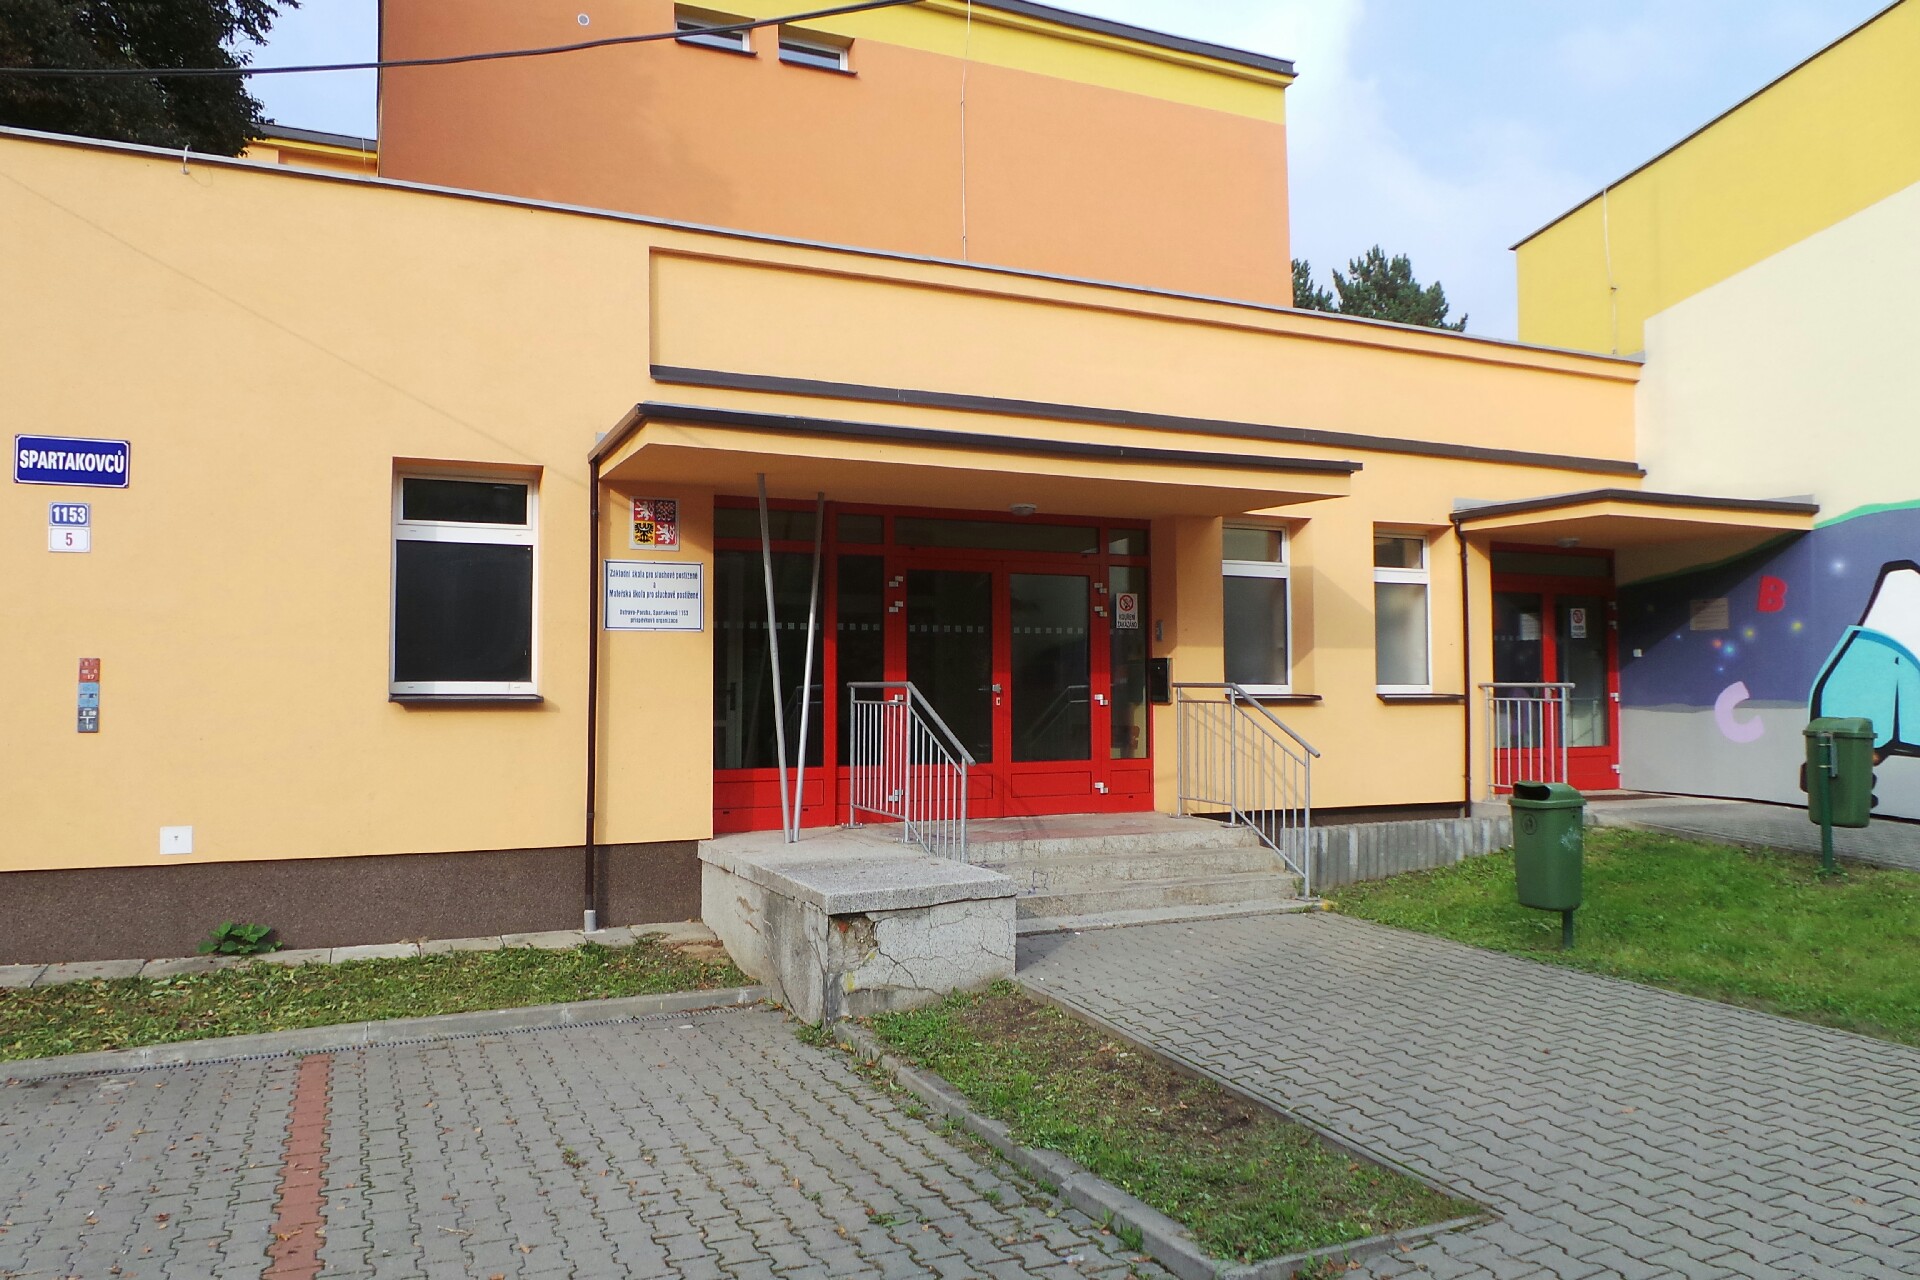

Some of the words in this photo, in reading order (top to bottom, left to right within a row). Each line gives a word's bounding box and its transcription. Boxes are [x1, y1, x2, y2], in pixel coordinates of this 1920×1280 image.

[19, 449, 124, 473] SPARTAKOVCŮ
[53, 506, 86, 523] 1153
[65, 532, 73, 546] 5
[645, 571, 653, 579] pro
[632, 589, 645, 599] škola
[646, 591, 654, 599] pro
[1757, 575, 1788, 613] B
[1714, 680, 1765, 744] C
